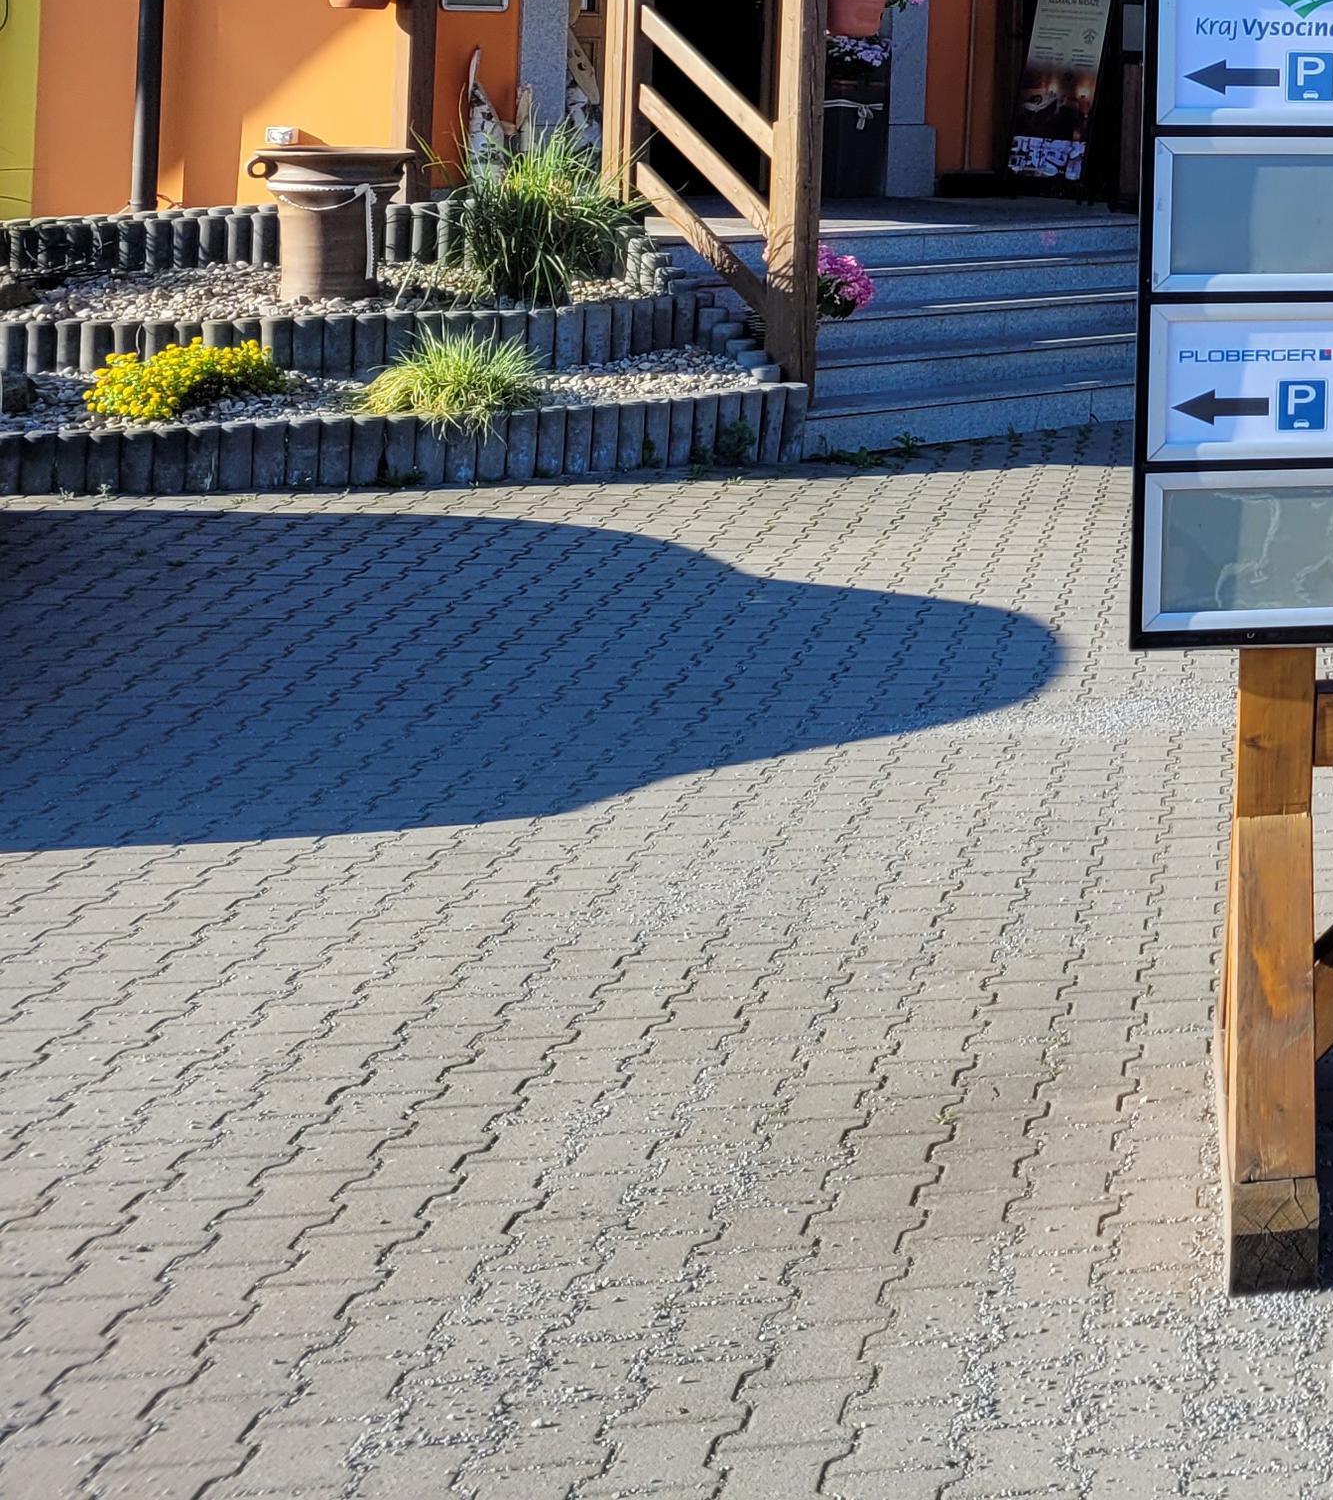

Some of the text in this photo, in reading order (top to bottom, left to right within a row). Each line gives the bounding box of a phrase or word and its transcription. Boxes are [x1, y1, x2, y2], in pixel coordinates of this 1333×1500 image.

[1196, 17, 1238, 41] Kraj
[1296, 56, 1326, 86] P
[1179, 349, 1316, 363] PLOBERGER
[1287, 385, 1317, 416] P
